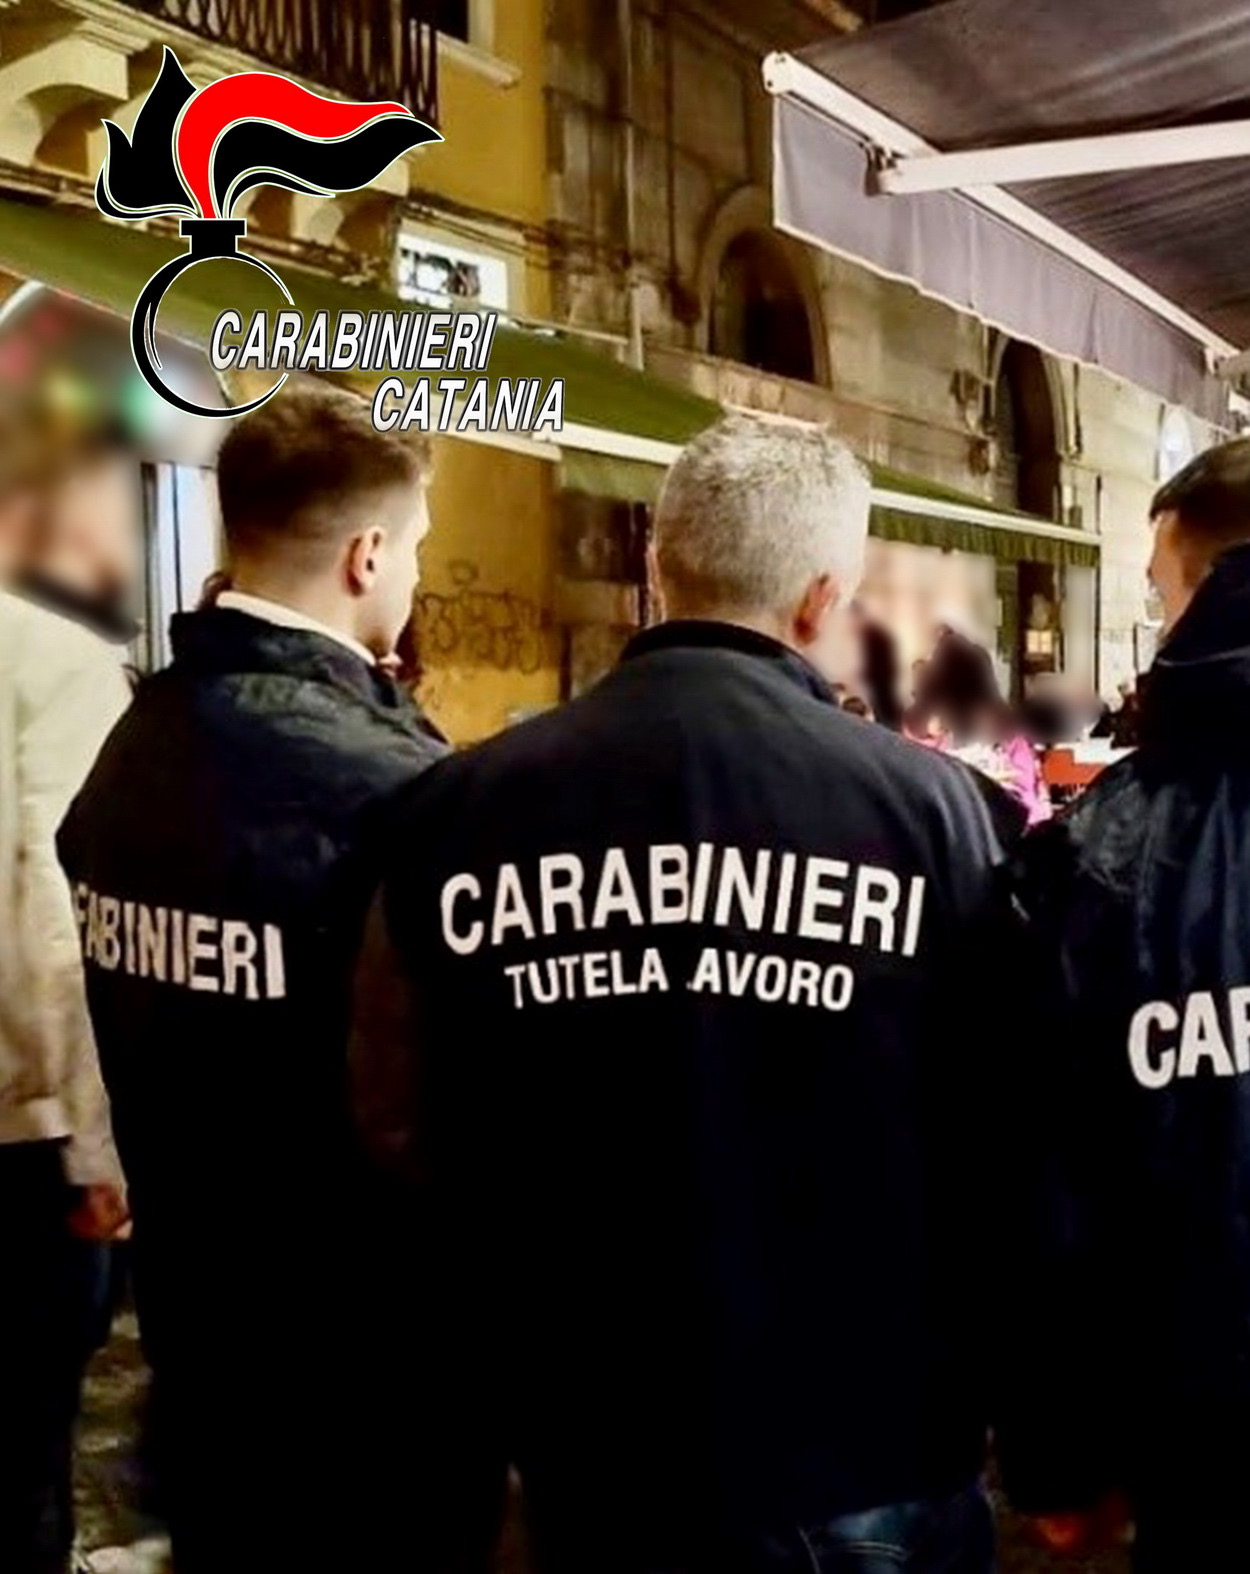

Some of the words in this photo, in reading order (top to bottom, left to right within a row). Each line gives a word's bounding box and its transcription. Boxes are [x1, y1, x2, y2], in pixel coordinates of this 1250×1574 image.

[440, 842, 926, 956] CARABINIERI
[504, 947, 669, 1009] TUTELA
[686, 947, 855, 1011] AVORO
